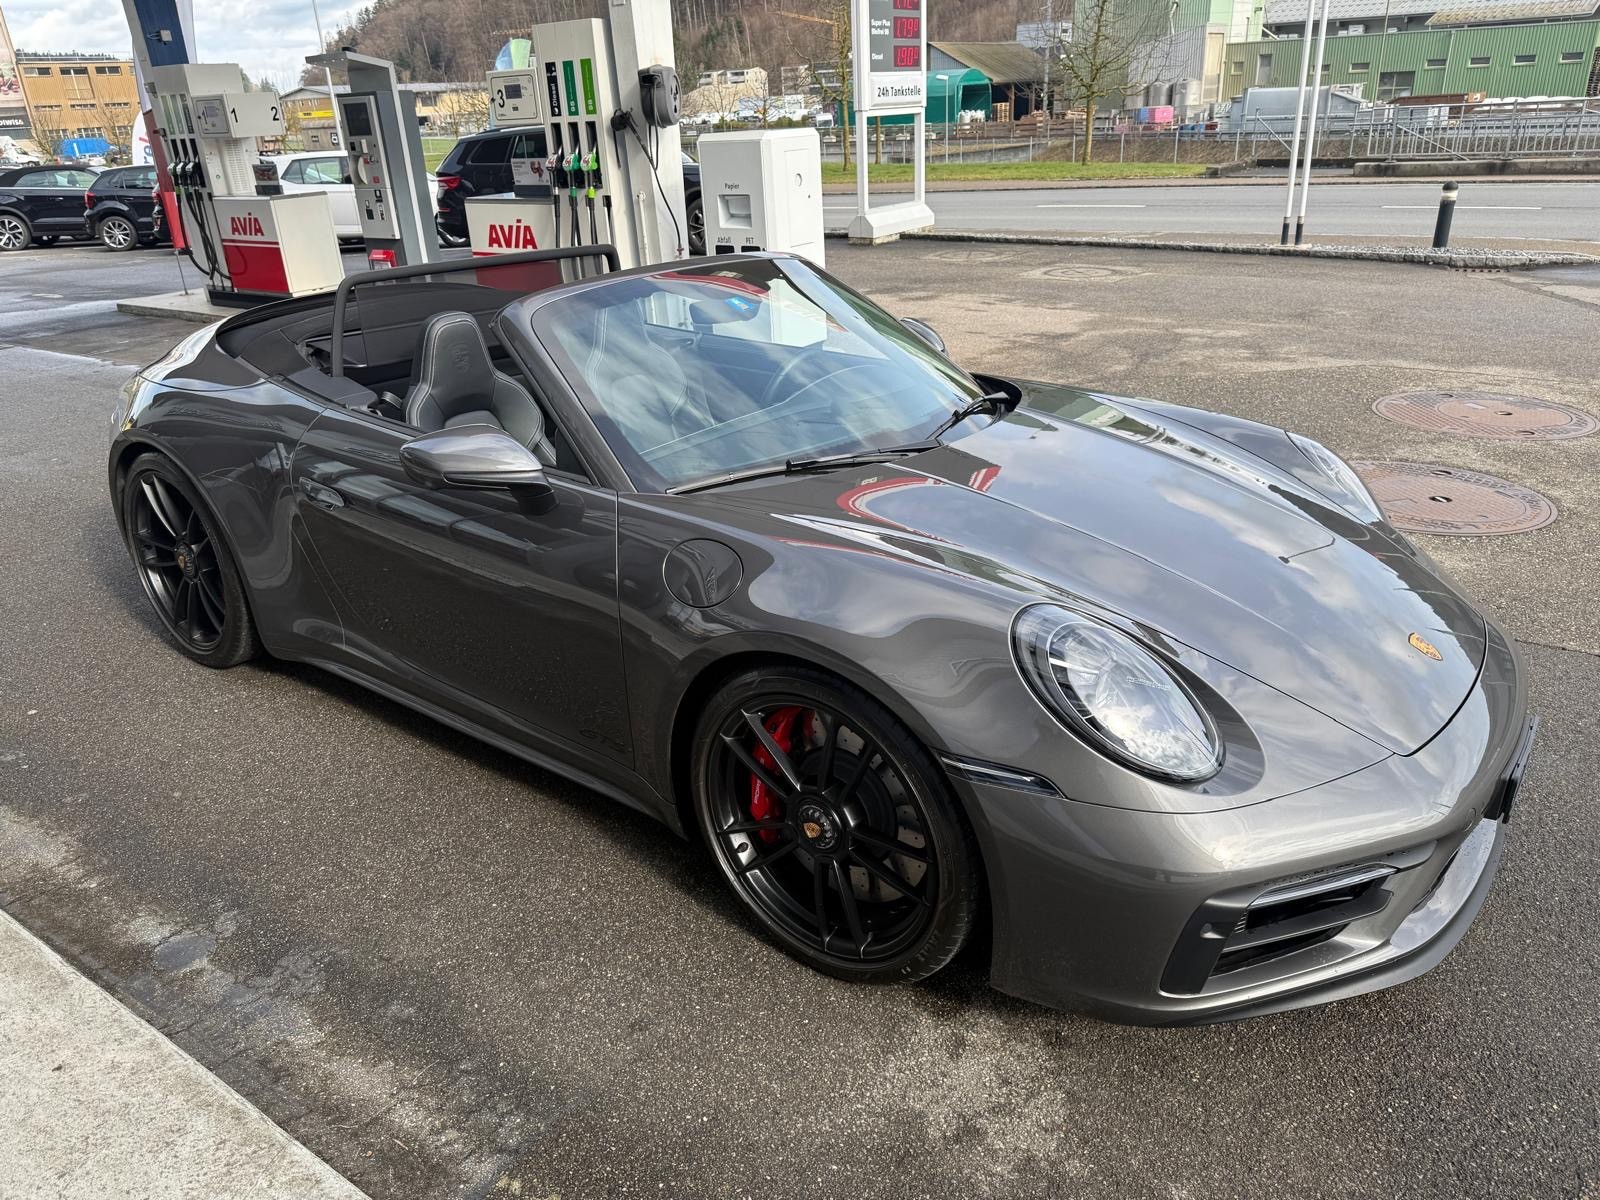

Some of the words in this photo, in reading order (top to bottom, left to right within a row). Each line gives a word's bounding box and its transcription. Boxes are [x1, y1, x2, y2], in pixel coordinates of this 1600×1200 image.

[497, 89, 505, 108] 3
[550, 83, 559, 106] Diesel
[877, 87, 890, 97] 24h
[890, 85, 921, 96] Tankstelle
[231, 108, 238, 123] 1
[270, 106, 279, 121] 2
[724, 183, 740, 191] Papier
[230, 212, 264, 236] AVIA
[488, 219, 538, 249] AVIA
[717, 236, 731, 244] Abfall
[745, 237, 754, 245] PET
